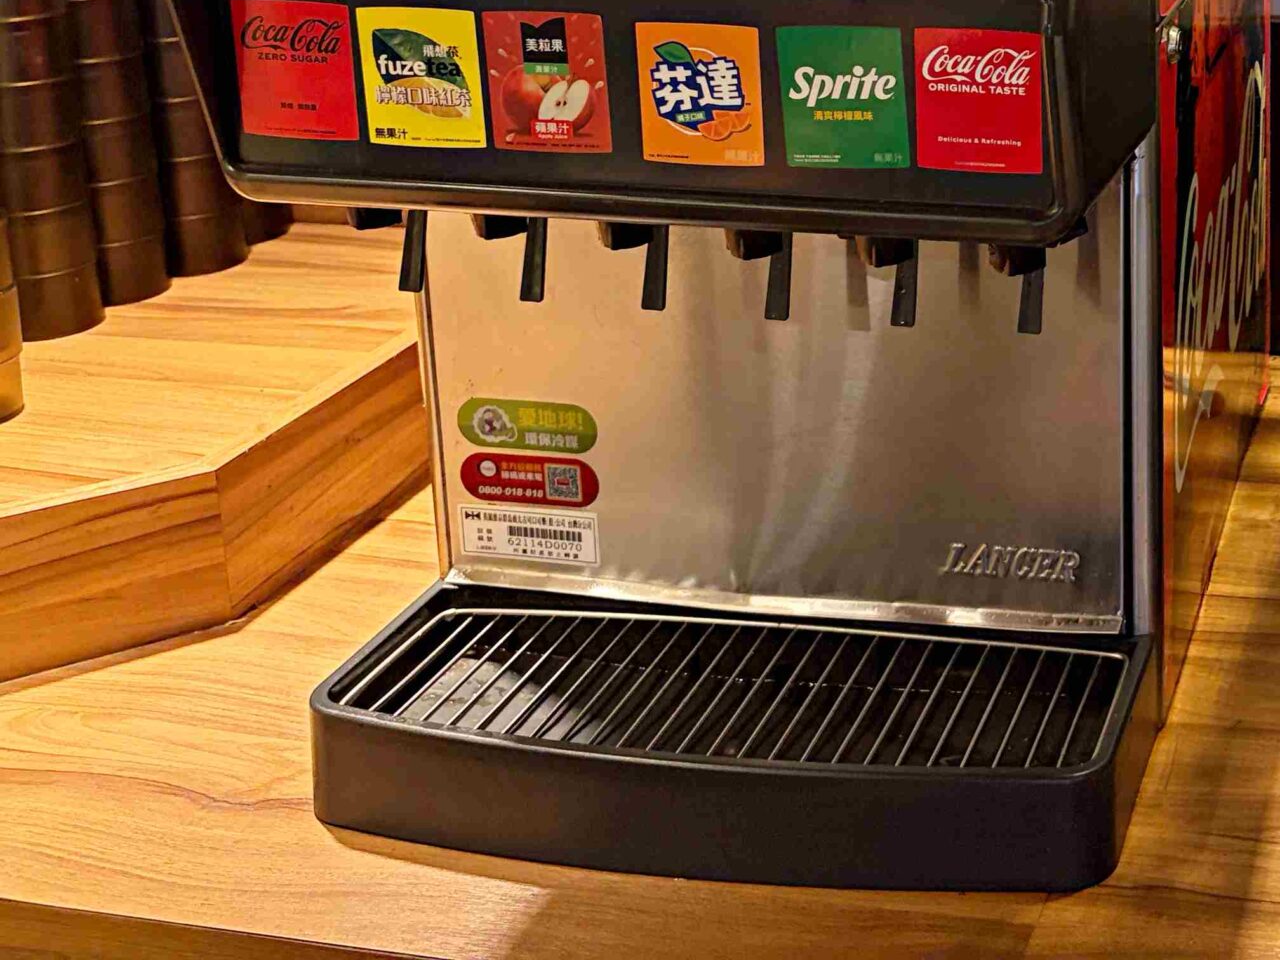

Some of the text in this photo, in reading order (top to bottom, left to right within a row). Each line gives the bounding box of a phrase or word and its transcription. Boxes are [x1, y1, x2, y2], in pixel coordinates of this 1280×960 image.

[241, 16, 345, 54] Coca-Cola
[525, 38, 564, 52] 美粒果
[257, 52, 328, 64] ZERO SUGAR
[922, 45, 1037, 85] Coca-Cola
[653, 59, 742, 114] 芬達
[788, 65, 896, 107] Sprite
[928, 83, 1026, 96] ORIGINAL TASTE
[375, 85, 472, 108] 檸檬口味紅茶
[375, 127, 408, 140] 無果汁
[535, 122, 569, 134] 蘋果汁
[937, 136, 972, 144] Delicious
[981, 138, 1021, 147] Refreshing
[507, 538, 582, 552] 62114D0070
[939, 542, 1081, 581] LANCER
